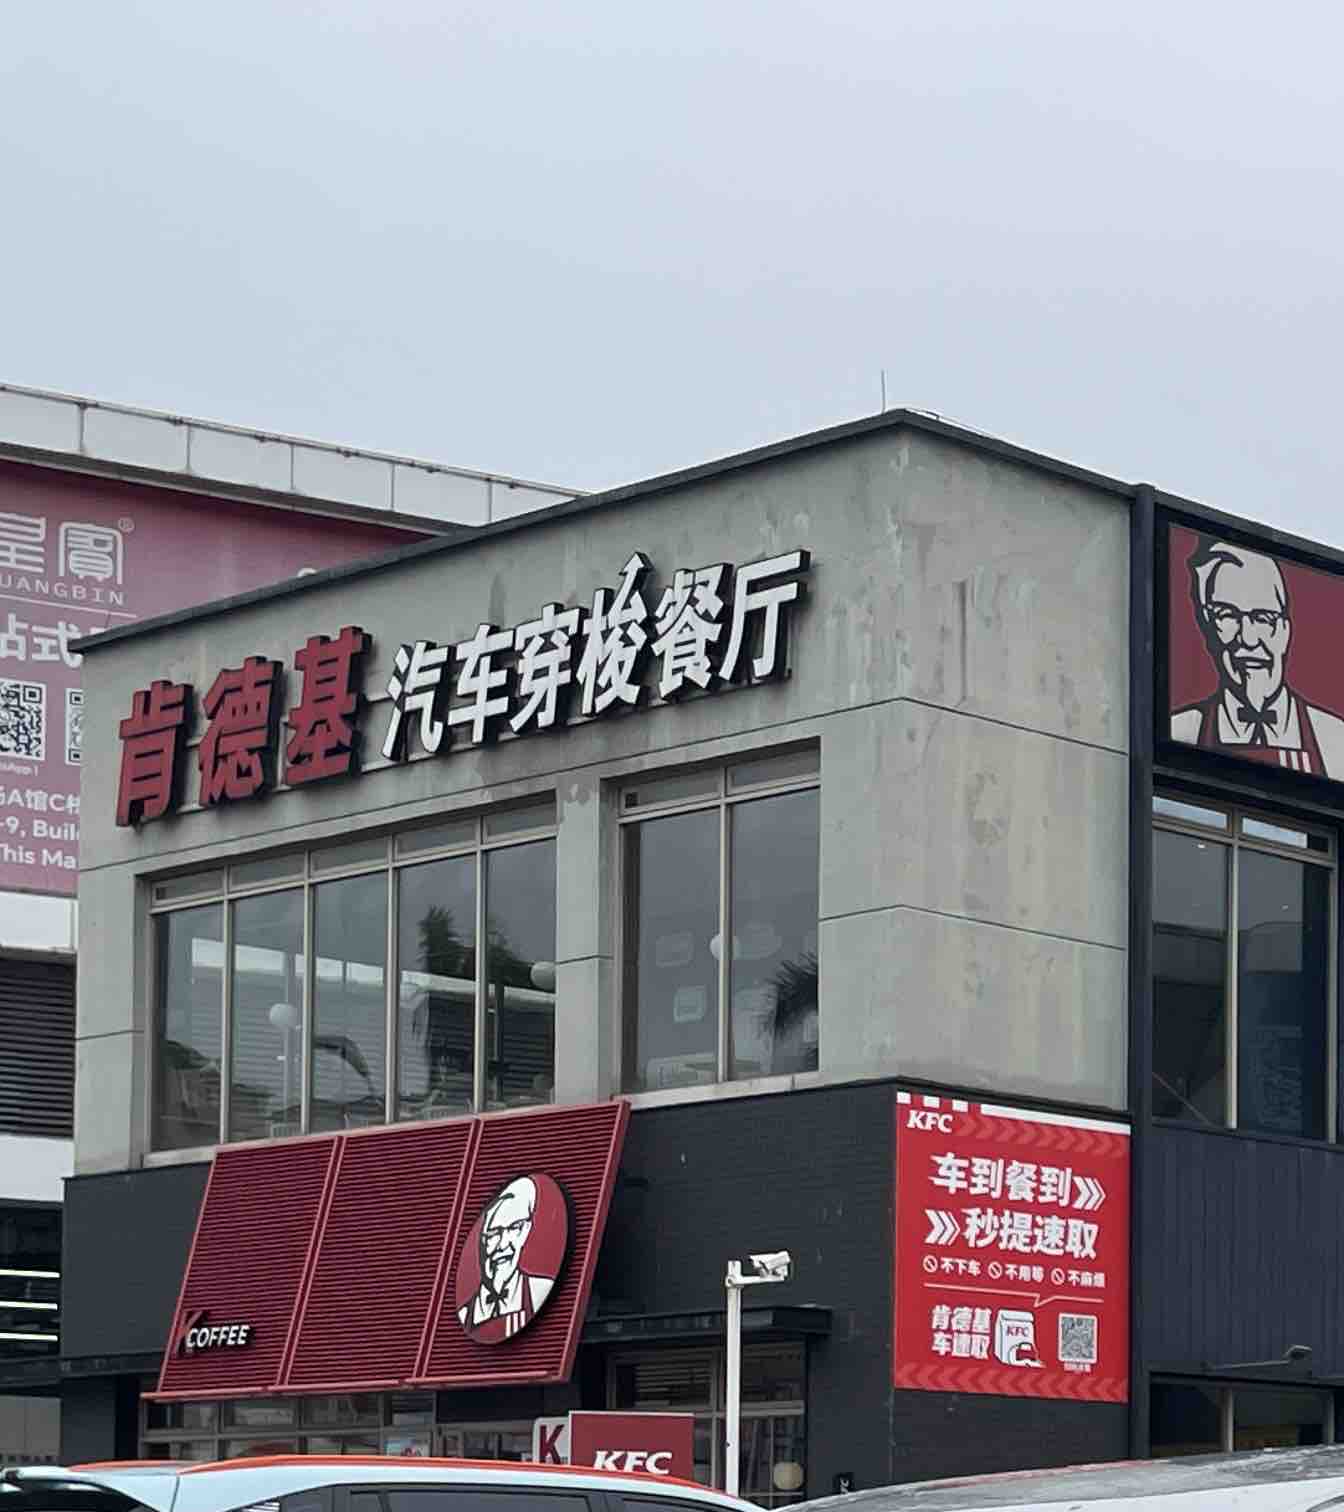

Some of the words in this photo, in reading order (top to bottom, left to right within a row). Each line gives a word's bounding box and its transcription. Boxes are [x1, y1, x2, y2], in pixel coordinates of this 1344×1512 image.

[116, 624, 372, 828] 肯德基
[382, 549, 812, 761] 汽车穿梭餐厅
[32, 819, 80, 841] Buil
[906, 1109, 953, 1134] KFC
[928, 1152, 1072, 1208] 车到餐到
[963, 1207, 1099, 1260] 秒提速取
[186, 1325, 250, 1348] COFFEE
[593, 1450, 673, 1476] KFC
